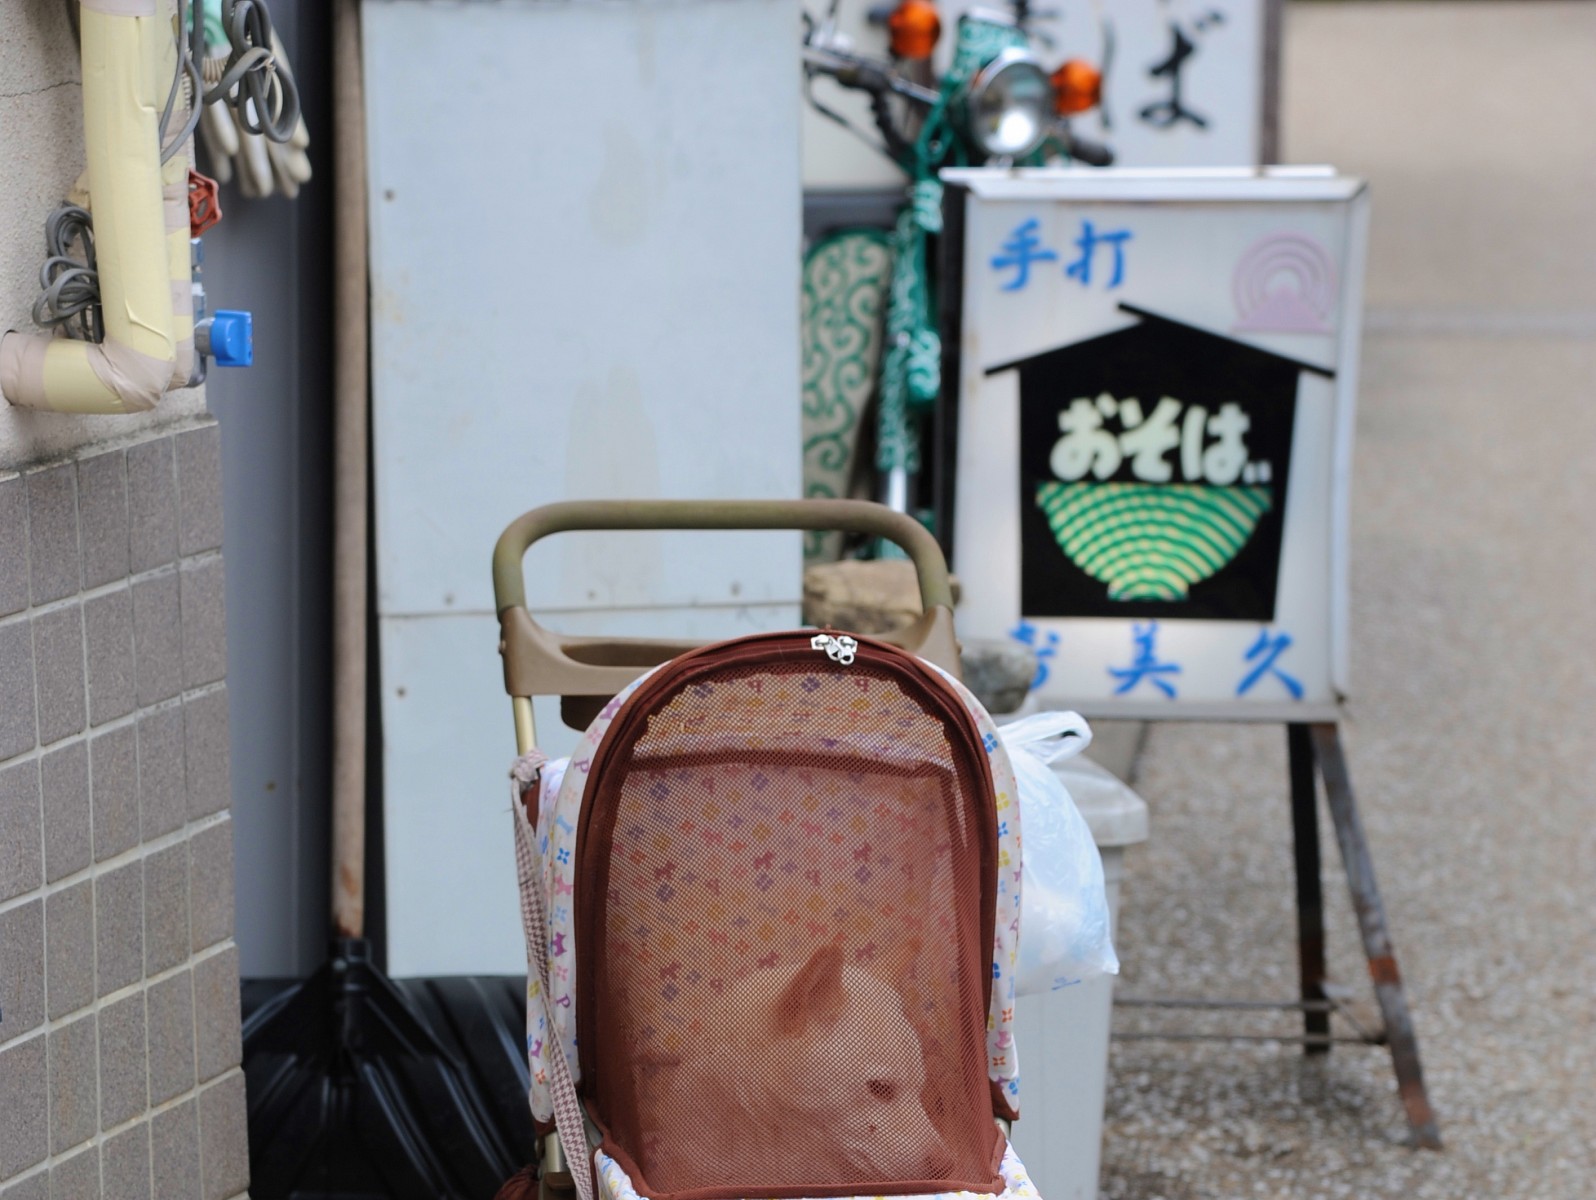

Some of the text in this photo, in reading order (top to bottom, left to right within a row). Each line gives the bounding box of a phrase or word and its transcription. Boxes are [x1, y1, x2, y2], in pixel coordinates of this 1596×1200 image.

[989, 216, 1134, 293] 手打
[1050, 393, 1271, 485] おそば
